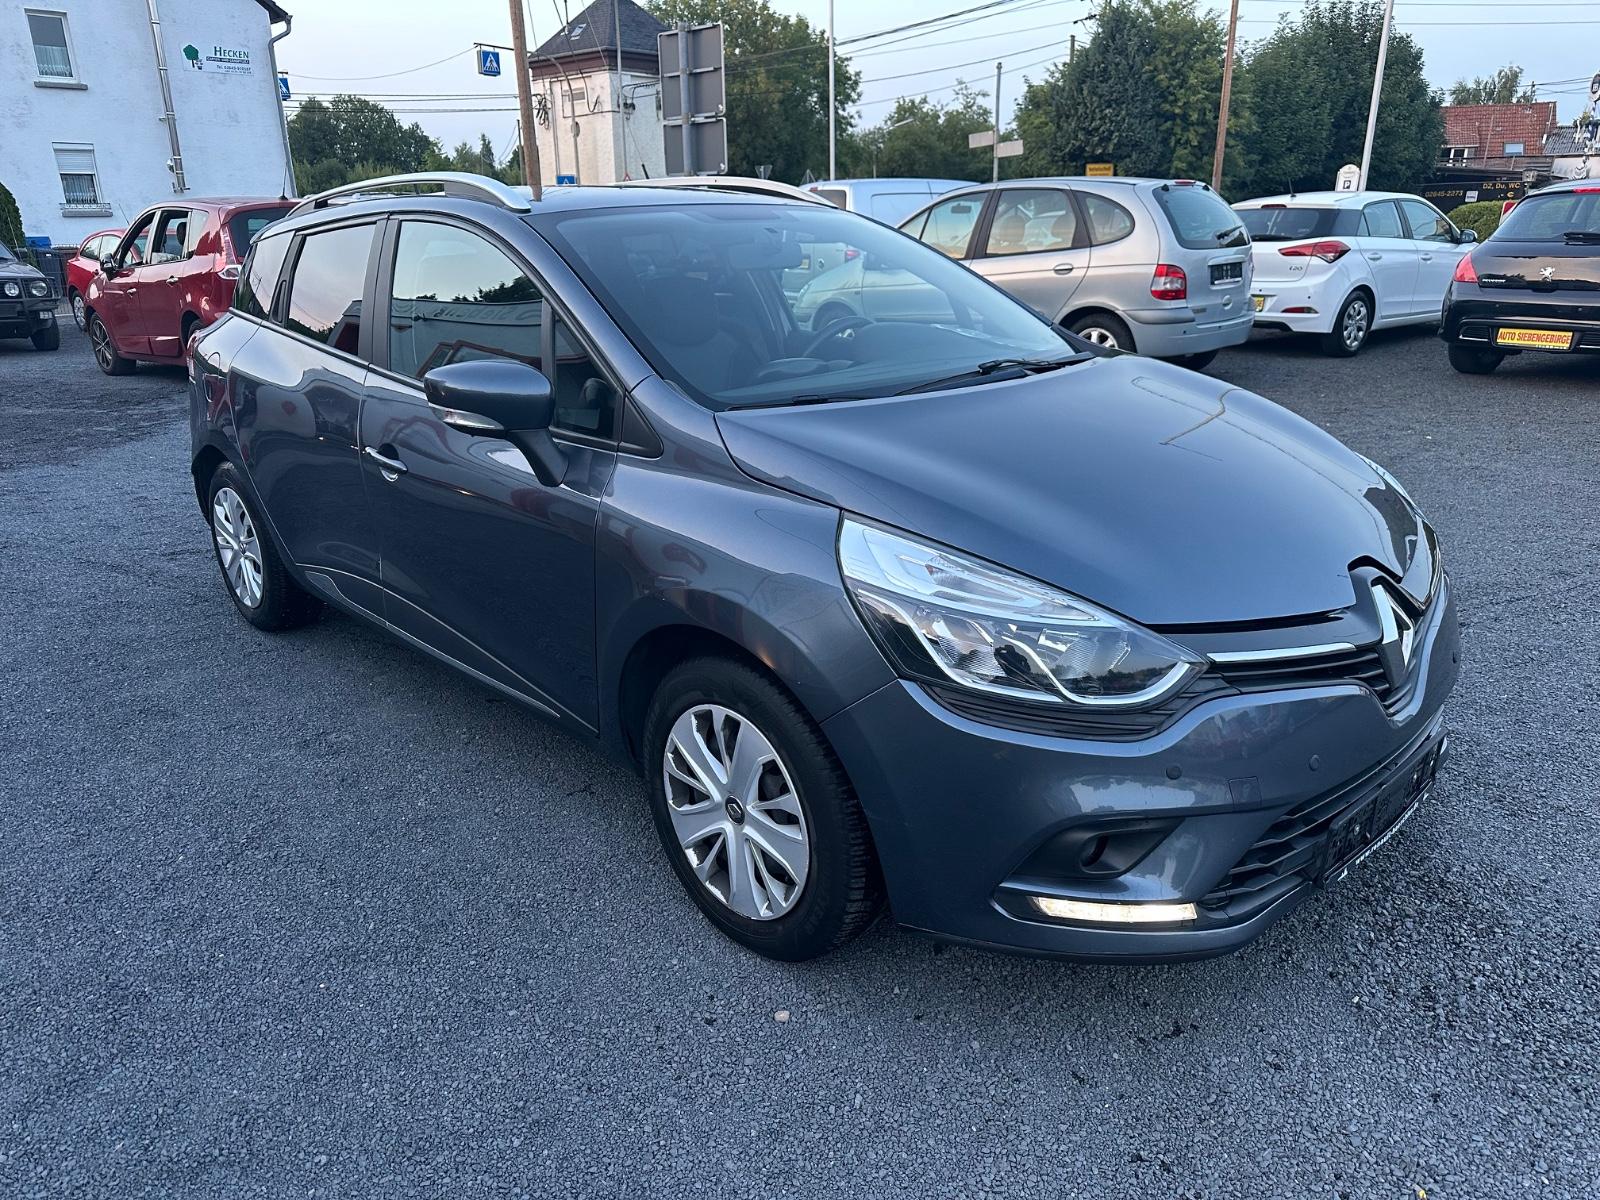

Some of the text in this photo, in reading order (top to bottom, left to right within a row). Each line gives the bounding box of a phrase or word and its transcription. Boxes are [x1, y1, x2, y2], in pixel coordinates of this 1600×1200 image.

[214, 46, 249, 59] HECKEN
[1498, 330, 1570, 345] AUTO SIEBENGEBIRGE
